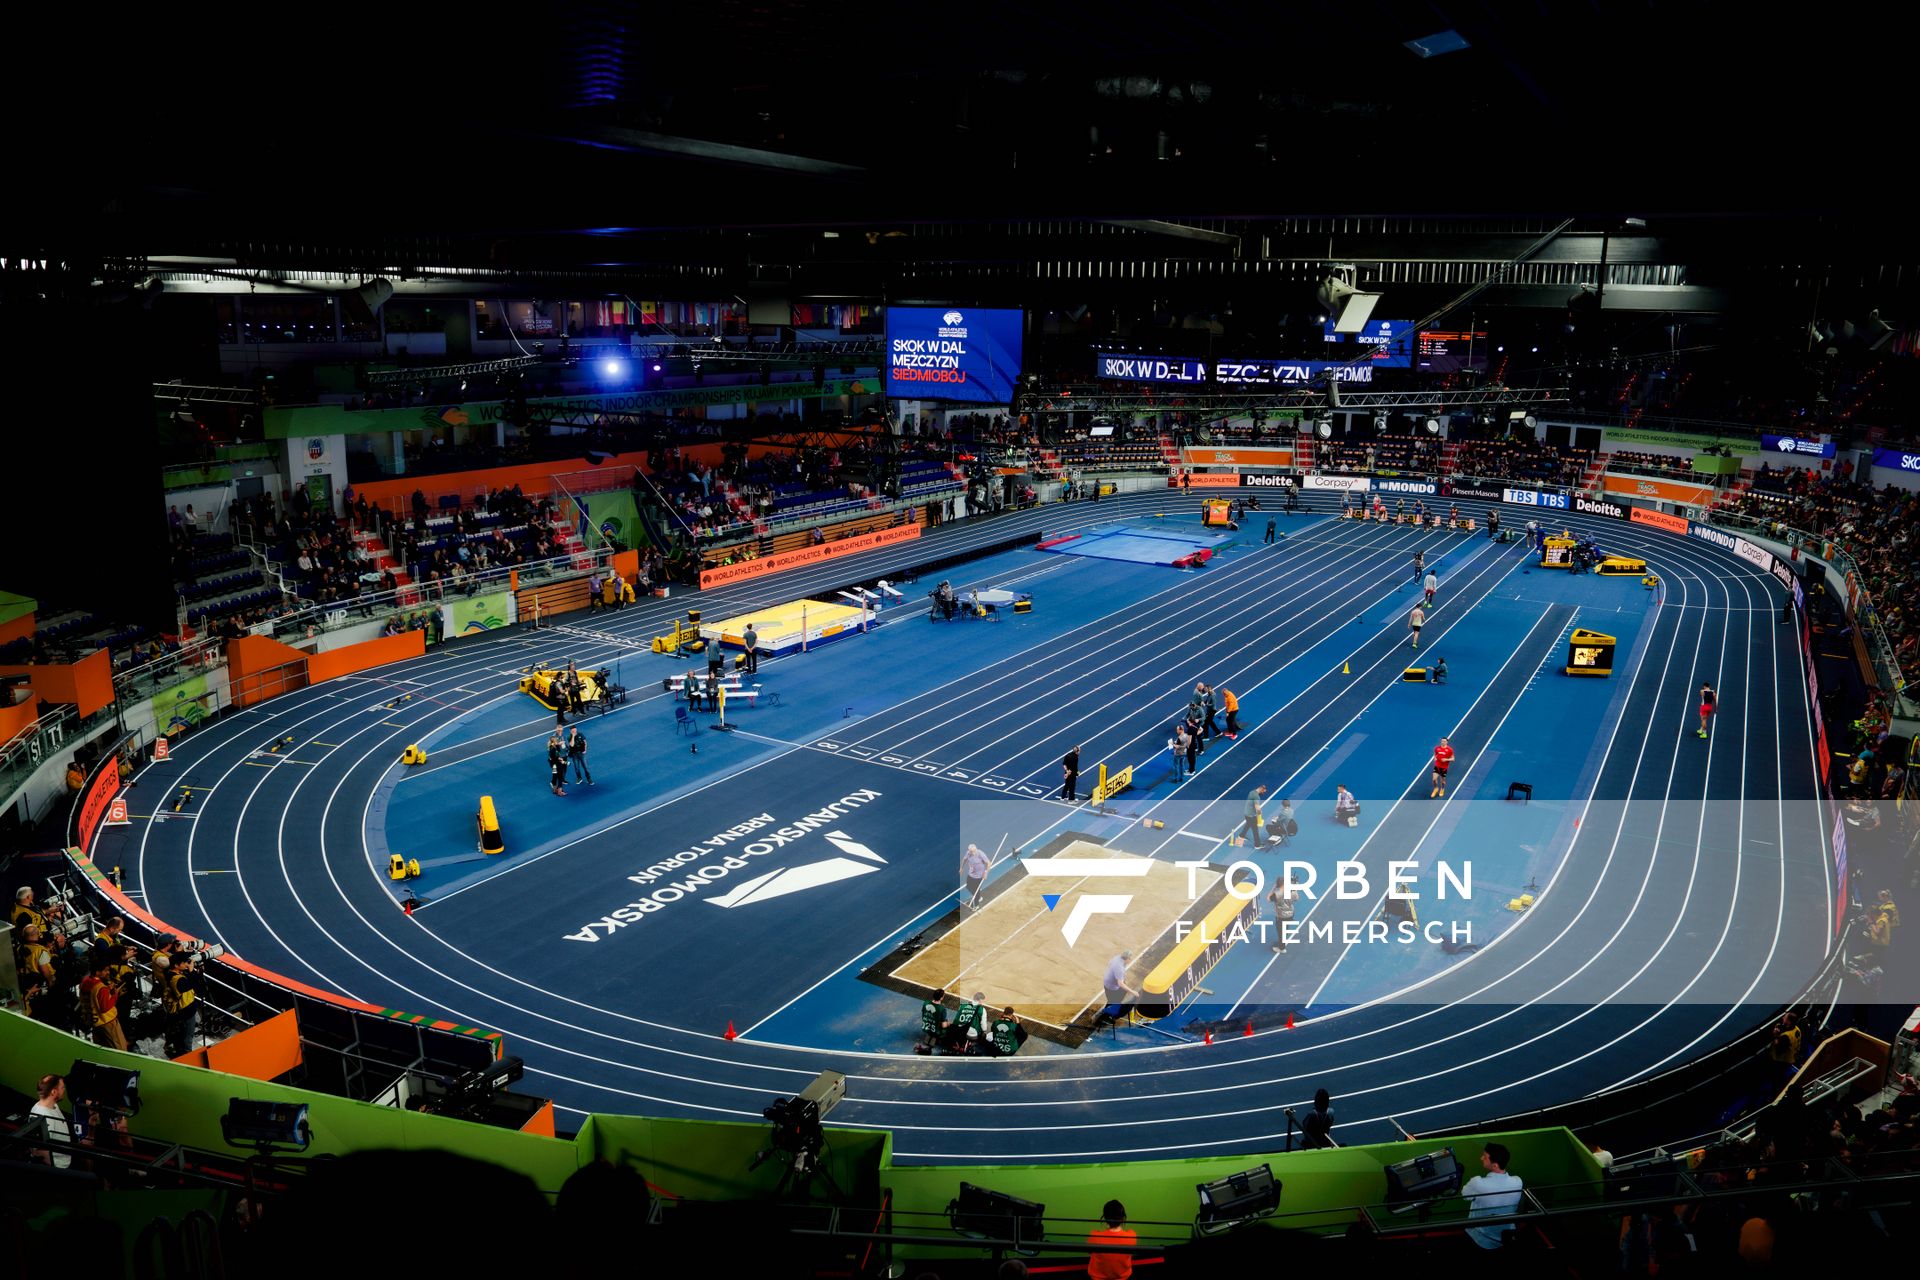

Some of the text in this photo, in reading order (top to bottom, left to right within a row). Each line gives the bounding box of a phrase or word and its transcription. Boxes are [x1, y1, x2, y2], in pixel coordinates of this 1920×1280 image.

[893, 339, 966, 354] SKOK W DAL
[892, 352, 959, 369] MĘŻCZYZN
[1106, 358, 1135, 377] SKOK
[1137, 361, 1153, 378] W
[892, 367, 967, 383] SIEDMIOBÓJ
[605, 395, 651, 411] INDOOR
[652, 390, 741, 409] CHAMPIONSHIPS
[743, 387, 780, 400] KUJAWY
[1315, 477, 1355, 489] Corpay
[1388, 482, 1436, 494] MONDO
[1452, 488, 1500, 498] Pinsent Masons
[1510, 491, 1532, 503] TBS
[1542, 494, 1565, 508] TBS
[1576, 498, 1624, 518] Deloitte.
[1642, 513, 1686, 530] WORLD ATHLETICS
[1701, 528, 1735, 549] MONDO
[776, 549, 821, 567] WORLD ATHLETICS
[1742, 542, 1764, 566] Corpay
[713, 563, 763, 581] WORLD ATHLETICS
[325, 609, 348, 626] VIP
[48, 723, 63, 746] T1
[31, 737, 42, 762] S1
[158, 746, 168, 756] 5
[817, 741, 839, 750] 8
[850, 748, 869, 757] 7
[880, 756, 903, 765] 6
[913, 763, 937, 773] 5
[947, 771, 970, 780] 4
[982, 778, 1006, 788] 3
[1017, 785, 1043, 796] 2
[113, 807, 124, 820] 6
[627, 812, 776, 885] ARENA TORUŃ
[562, 788, 883, 943] KUJAWSKO-POMORSKA
